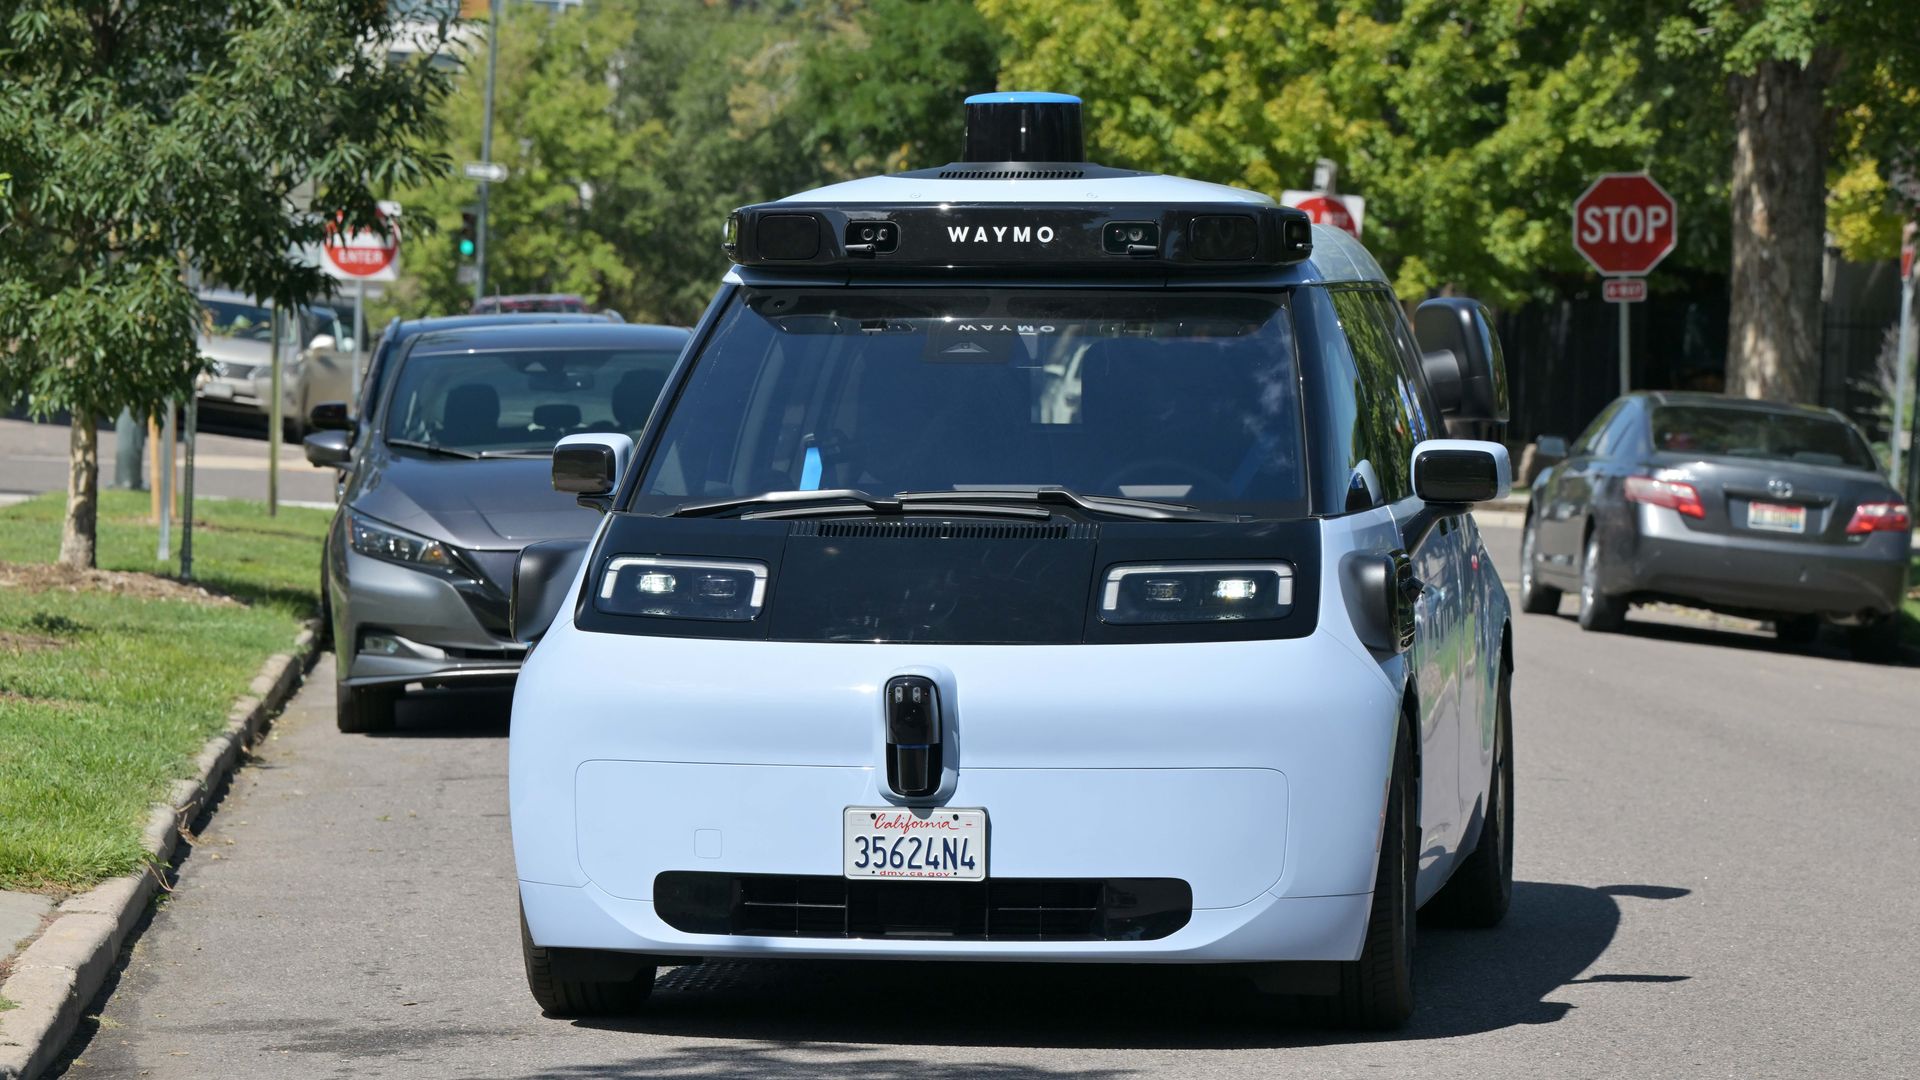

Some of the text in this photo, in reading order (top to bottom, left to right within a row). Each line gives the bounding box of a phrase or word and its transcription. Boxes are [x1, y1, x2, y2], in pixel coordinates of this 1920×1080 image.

[947, 226, 1054, 243] WAYMO
[1582, 205, 1668, 244] STOP
[338, 250, 383, 264] ENTER
[874, 813, 959, 834] California
[854, 836, 976, 870] 35624N4
